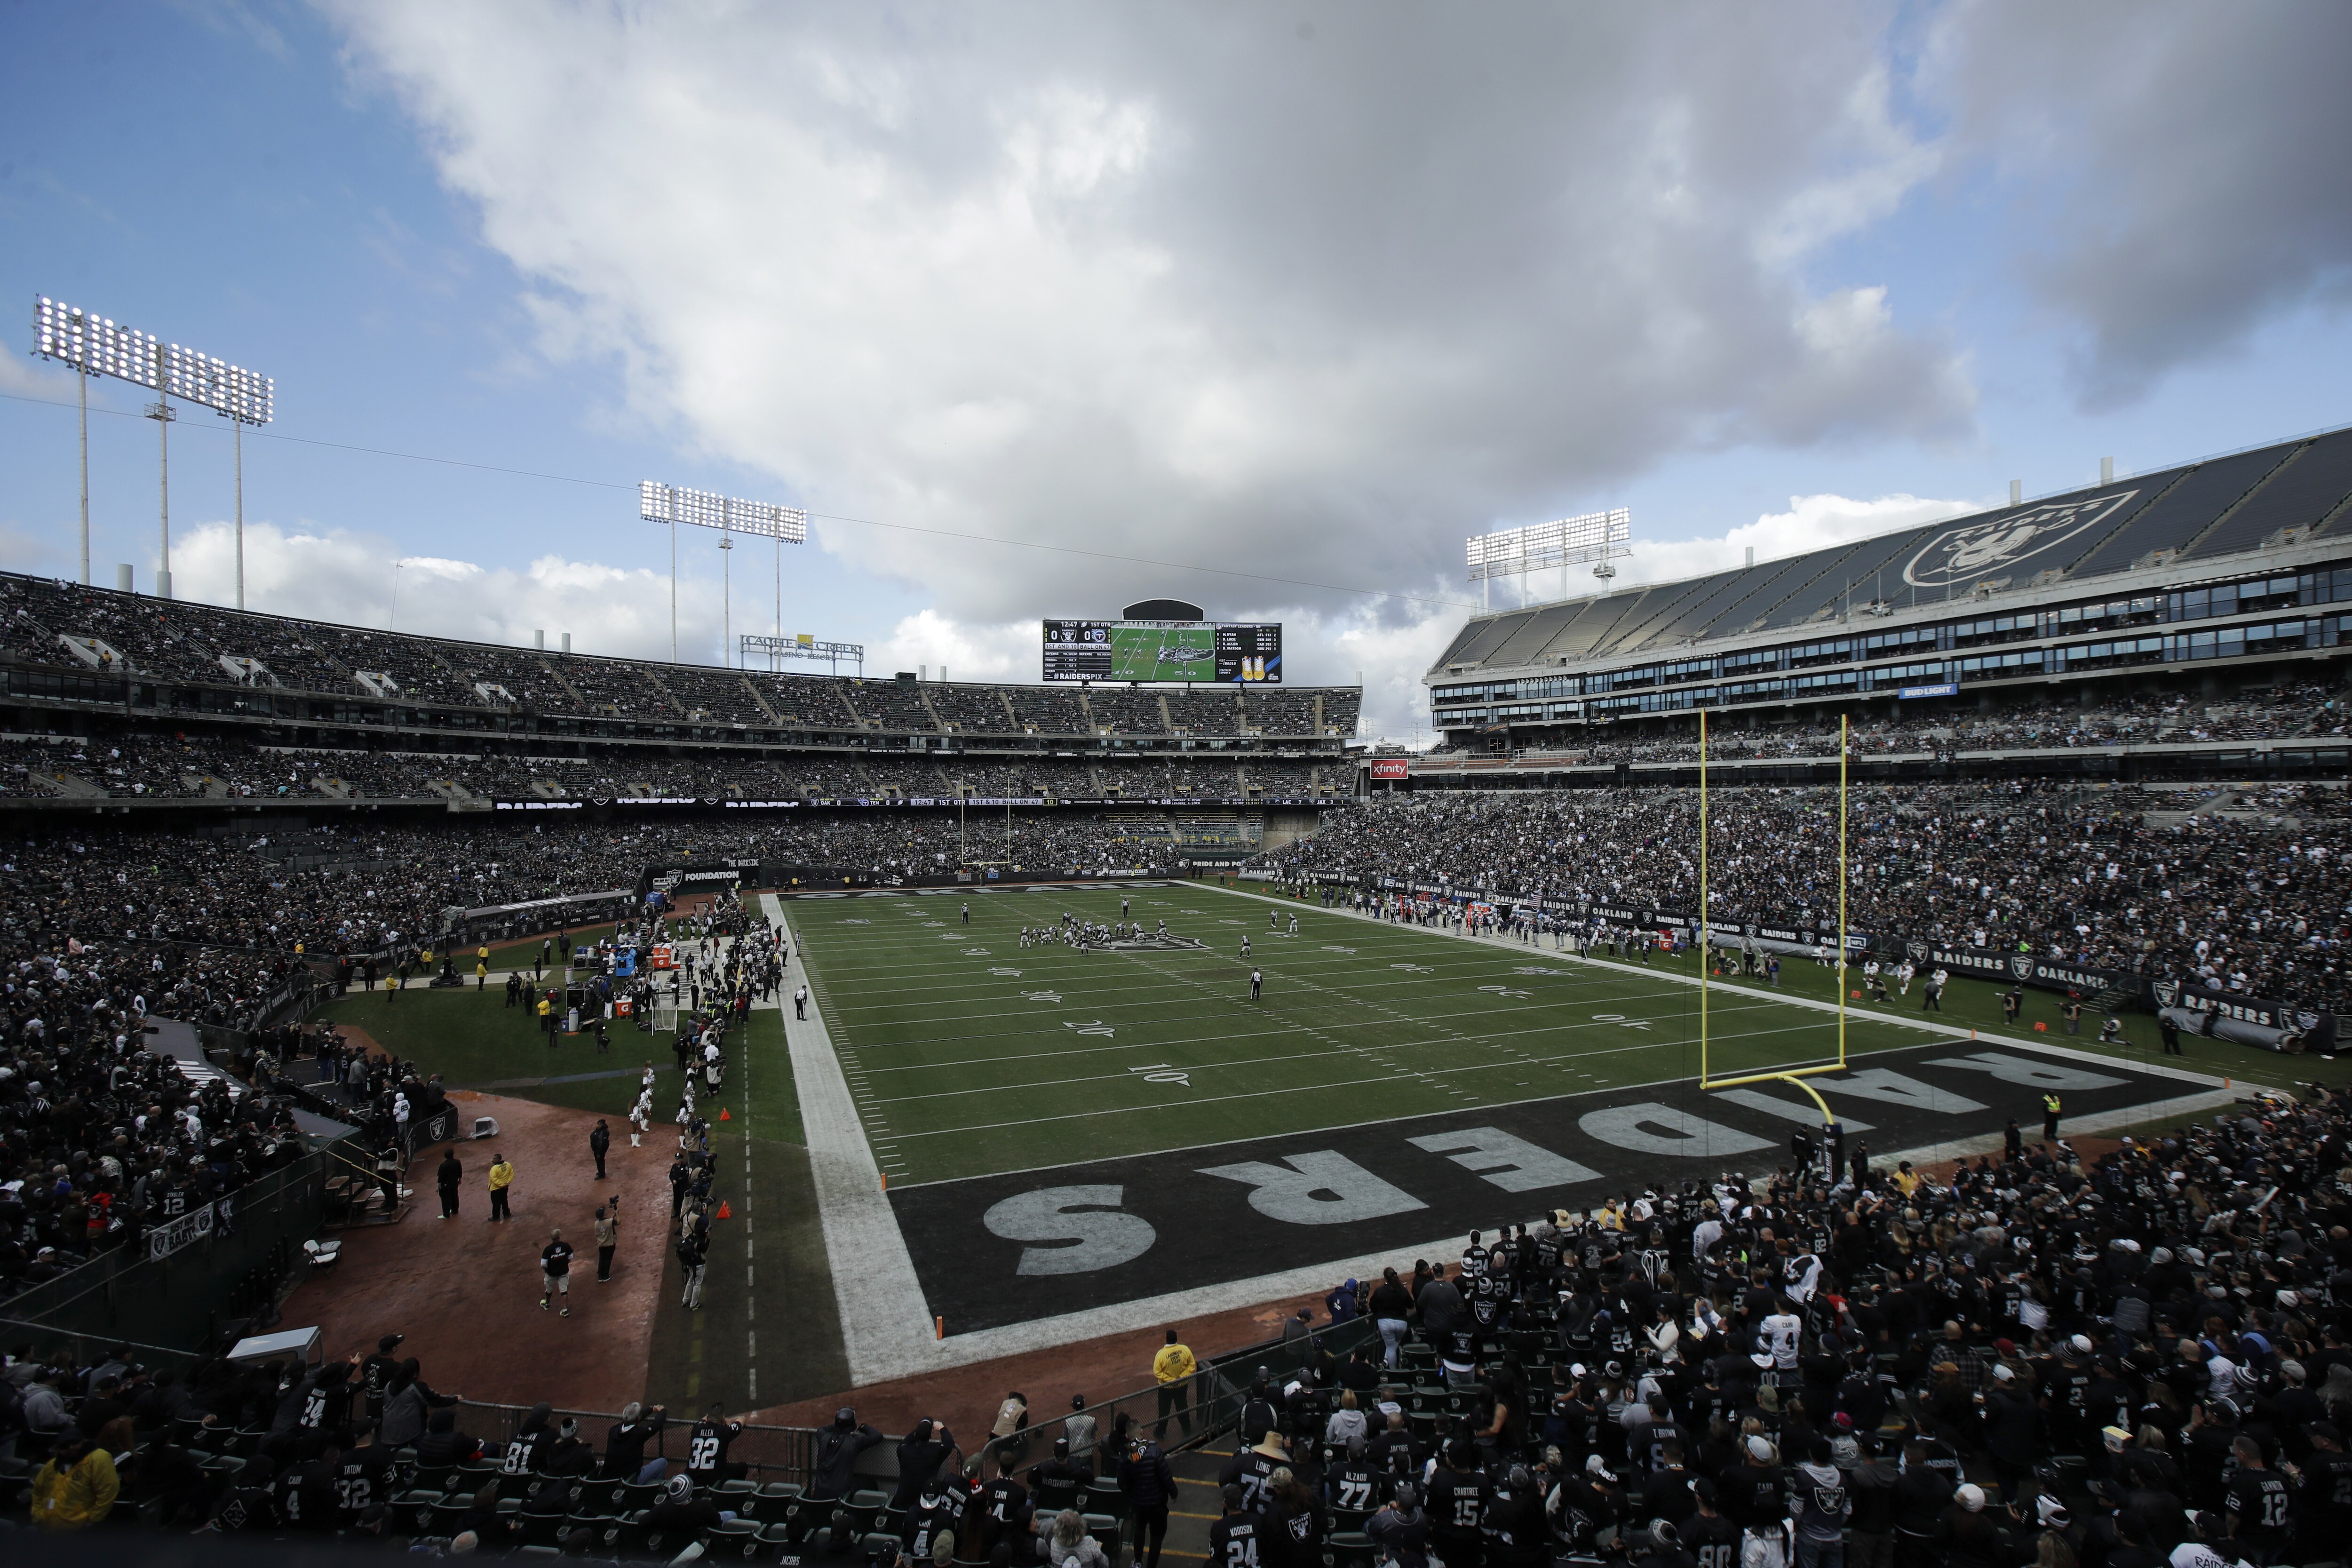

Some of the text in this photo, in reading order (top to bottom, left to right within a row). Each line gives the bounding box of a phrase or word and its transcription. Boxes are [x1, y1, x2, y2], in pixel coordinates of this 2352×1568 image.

[1954, 501, 2104, 539] RAIDERS
[746, 636, 793, 647] CACHE
[1051, 630, 1057, 640] 0
[1084, 631, 1090, 640] 0
[1924, 686, 1951, 694] LIGHT
[1374, 764, 1406, 775] xfinity
[685, 871, 739, 881] FOUNDATION
[796, 883, 1168, 899] OAKLAND
[1415, 885, 1441, 893] OAKLAND
[1495, 894, 1527, 905] OAKLAND
[1543, 900, 1574, 910] RAIDERS
[1593, 907, 1633, 919] OAKLAND
[1656, 915, 1684, 925] RAIDERS
[1705, 922, 1740, 932] OAKLAND
[1762, 929, 1796, 940] RAIDERS
[987, 966, 1023, 977] 40
[1933, 951, 2004, 971] RAIDERS
[2037, 966, 2108, 989] OAKLAND
[1020, 989, 1063, 1003] 30
[1477, 985, 1534, 1000] 20
[1062, 1020, 1115, 1038] 20
[1591, 1014, 1654, 1030] 10
[1127, 1063, 1192, 1088] 10
[983, 1052, 2133, 1275] RAIDERS
[163, 1197, 184, 1215] 12
[1683, 1207, 1698, 1221] 34
[170, 1220, 183, 1235] JUST
[1814, 1239, 1827, 1253] 82
[1504, 1252, 1519, 1268] 77
[1539, 1251, 1556, 1267] 72
[1473, 1260, 1488, 1276] 24
[1703, 1269, 1718, 1278] SEYMOUR
[1495, 1281, 1510, 1297] 24
[1620, 1299, 1629, 1313] 4
[2004, 1300, 2020, 1316] 12
[1611, 1333, 1632, 1352] 24
[1785, 1332, 1794, 1349] 4
[1166, 1350, 1182, 1359] LANDMARK
[1314, 1367, 1321, 1380] 4
[301, 1396, 326, 1427] 24
[2116, 1407, 2130, 1431] 4
[689, 1438, 719, 1469] 32
[1389, 1444, 1408, 1453] JACOBS
[503, 1442, 532, 1473] 81
[344, 1465, 362, 1474] TATUM
[1256, 1461, 1270, 1473] LONG
[288, 1475, 302, 1484] CARR
[1042, 1477, 1074, 1487] RAIDERS
[1346, 1472, 1367, 1481] ALZADO
[339, 1479, 371, 1509] 32
[1240, 1473, 1273, 1514] 75
[1454, 1487, 1478, 1496] CRABTREE
[2261, 1480, 2283, 1492] GANNON
[947, 1486, 967, 1504] WOODSON
[995, 1490, 1007, 1499] CARR
[1338, 1481, 1371, 1510] 77
[2226, 1494, 2241, 1509] 12
[286, 1490, 301, 1520] 4
[992, 1503, 1004, 1520] 4
[1454, 1499, 1478, 1527] 15
[2262, 1493, 2288, 1527] 12
[1289, 1515, 1309, 1525] RAIDERS
[1230, 1525, 1253, 1537] WOODSON
[914, 1530, 928, 1556] 4
[780, 1556, 800, 1565] JACOBS
[1227, 1538, 1261, 1568] 24
